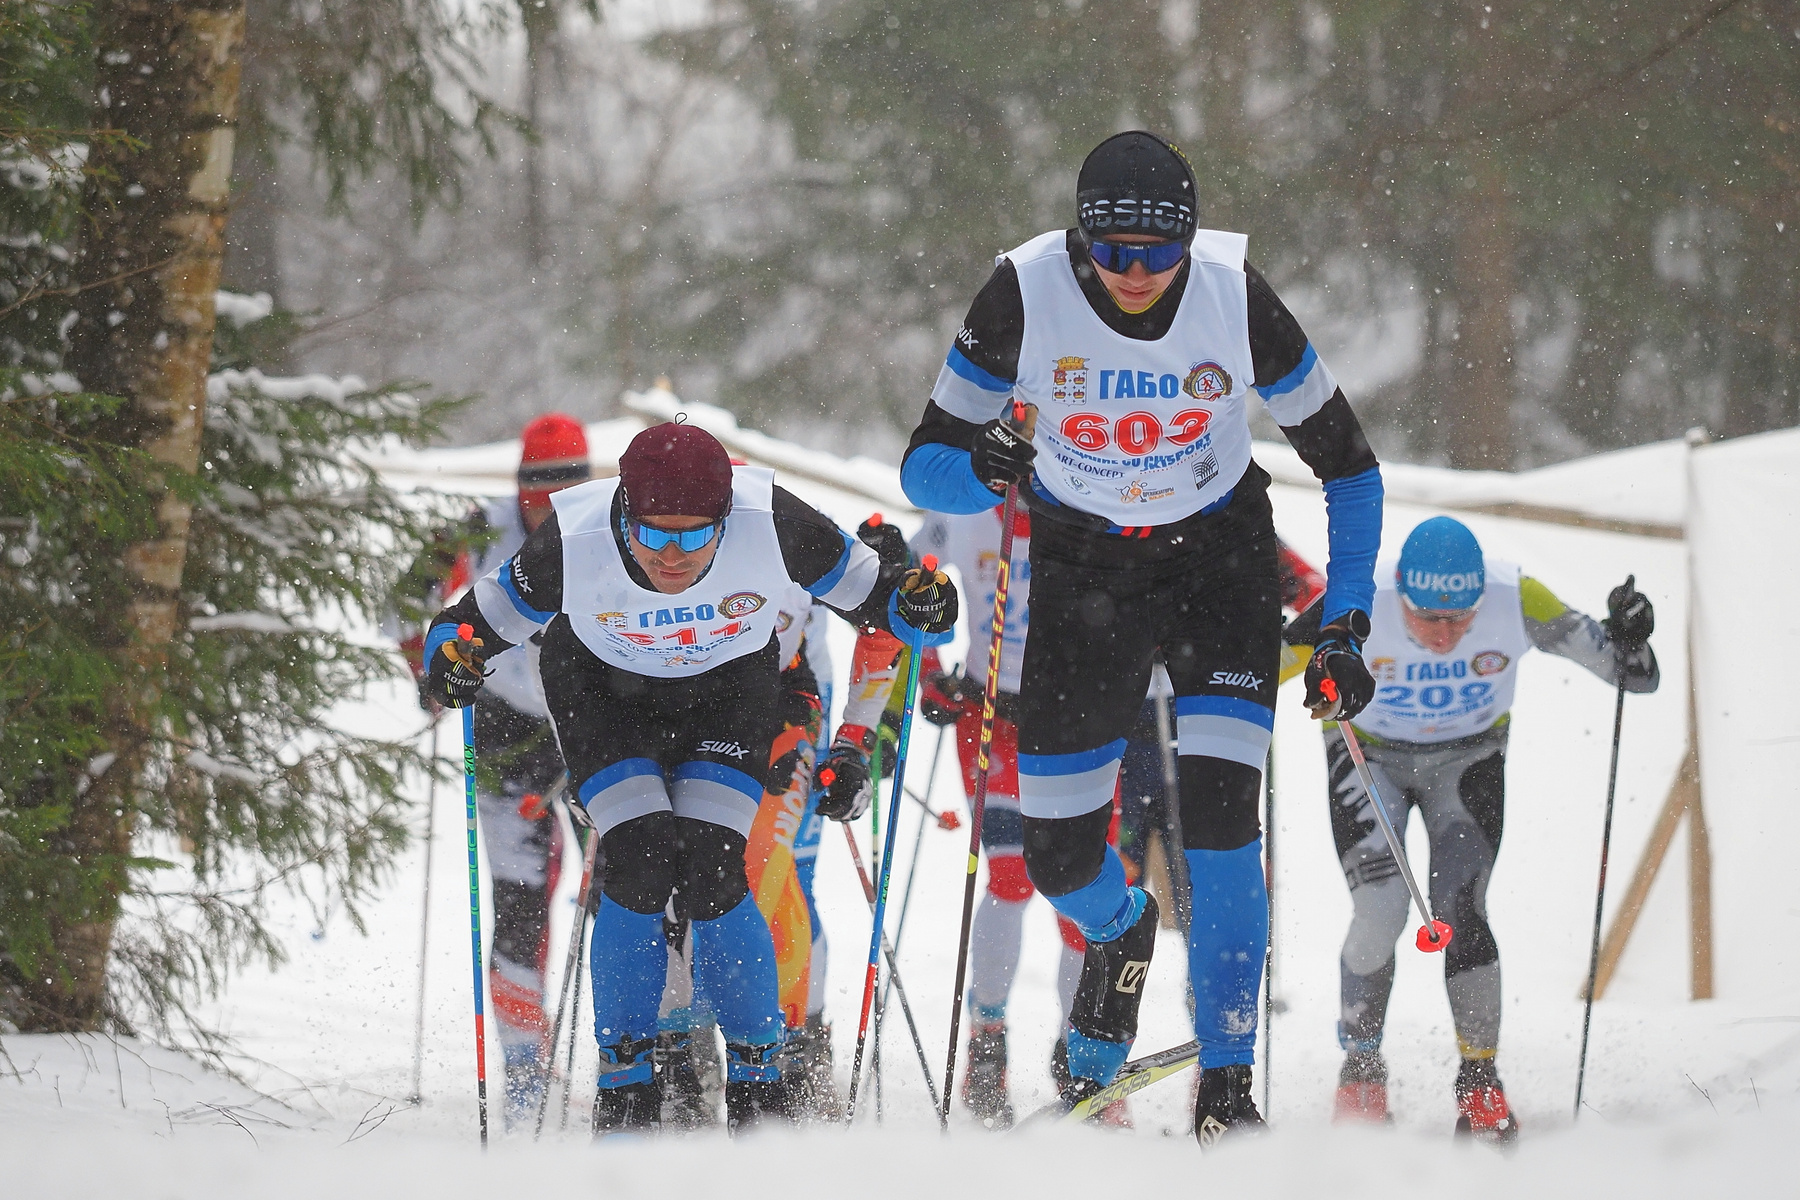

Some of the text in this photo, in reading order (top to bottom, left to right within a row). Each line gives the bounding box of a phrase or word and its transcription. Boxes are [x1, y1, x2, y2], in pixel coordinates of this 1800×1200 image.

[1100, 369, 1179, 400] ГАБО
[991, 426, 1018, 449] swix
[1060, 408, 1213, 456] 603
[1054, 452, 1125, 479] ART-CONCEPT
[1407, 569, 1481, 591] LUKOIL
[638, 603, 715, 628] ГАБО
[1208, 671, 1264, 691] swix
[1405, 659, 1467, 681] ГАБО
[696, 740, 750, 760] swix
[1087, 1071, 1152, 1117] FISCHER
